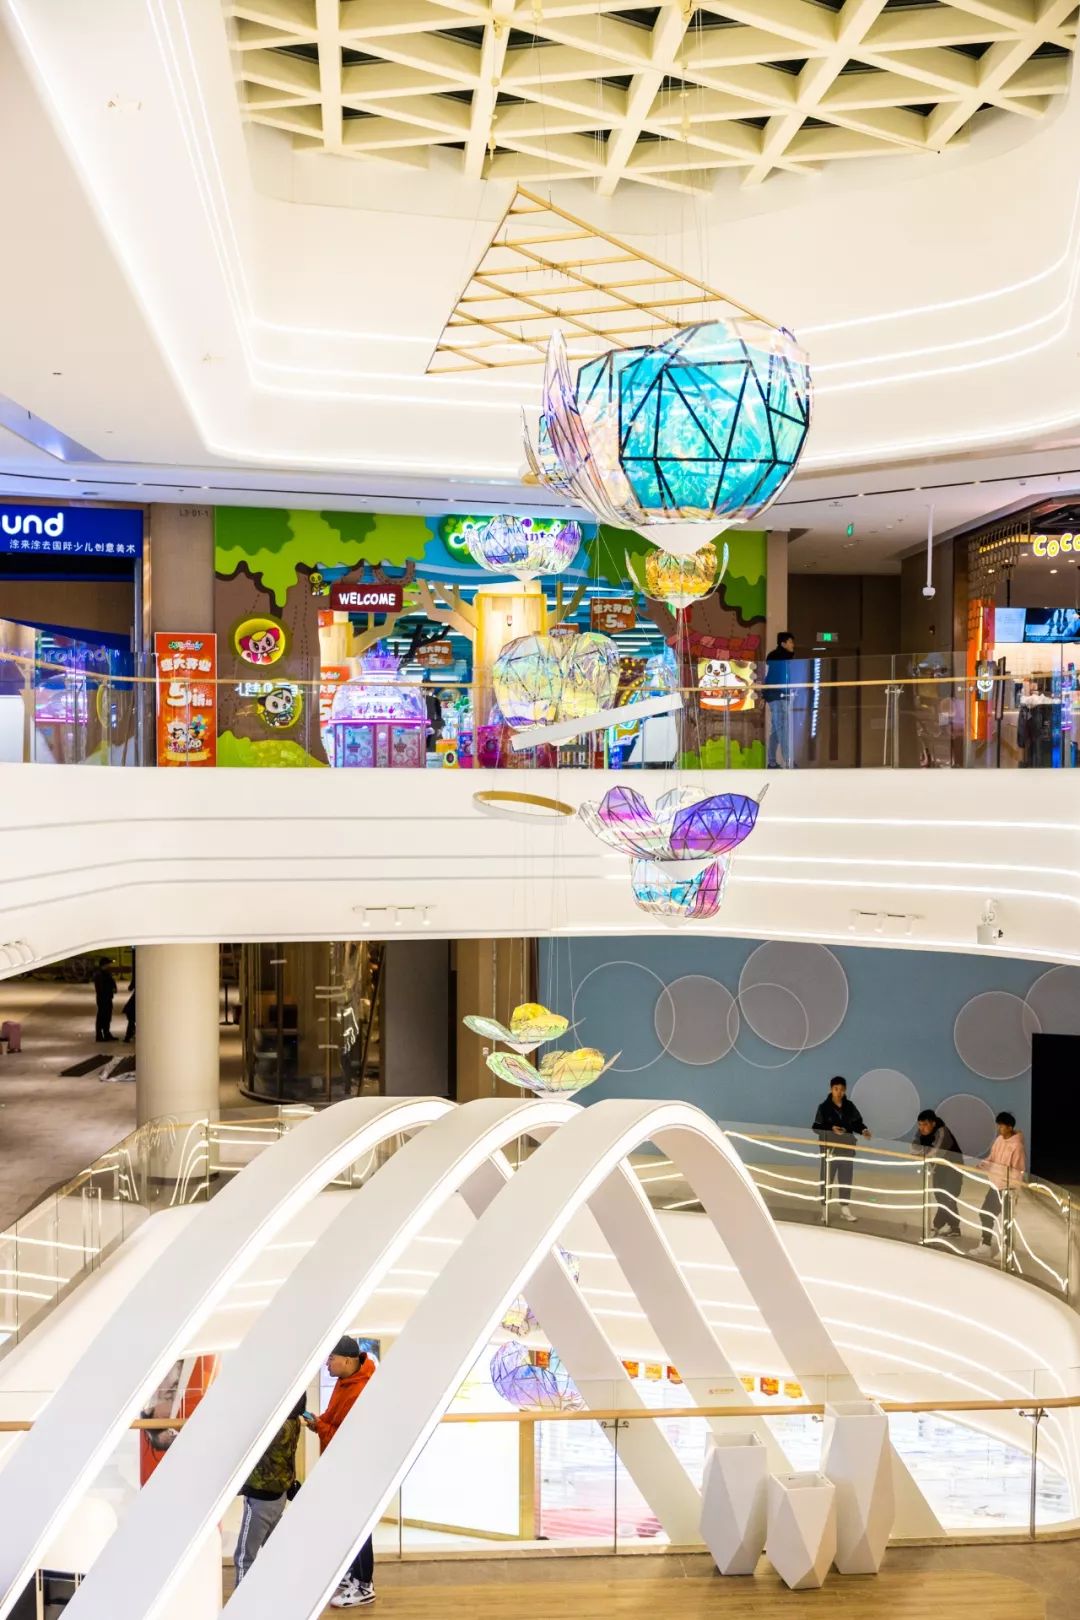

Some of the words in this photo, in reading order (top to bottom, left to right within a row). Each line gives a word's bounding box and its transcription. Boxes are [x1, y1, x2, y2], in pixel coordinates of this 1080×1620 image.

[9, 539, 136, 554] 涂来涂去国际少儿创意美术
[338, 592, 396, 606] WELCOME
